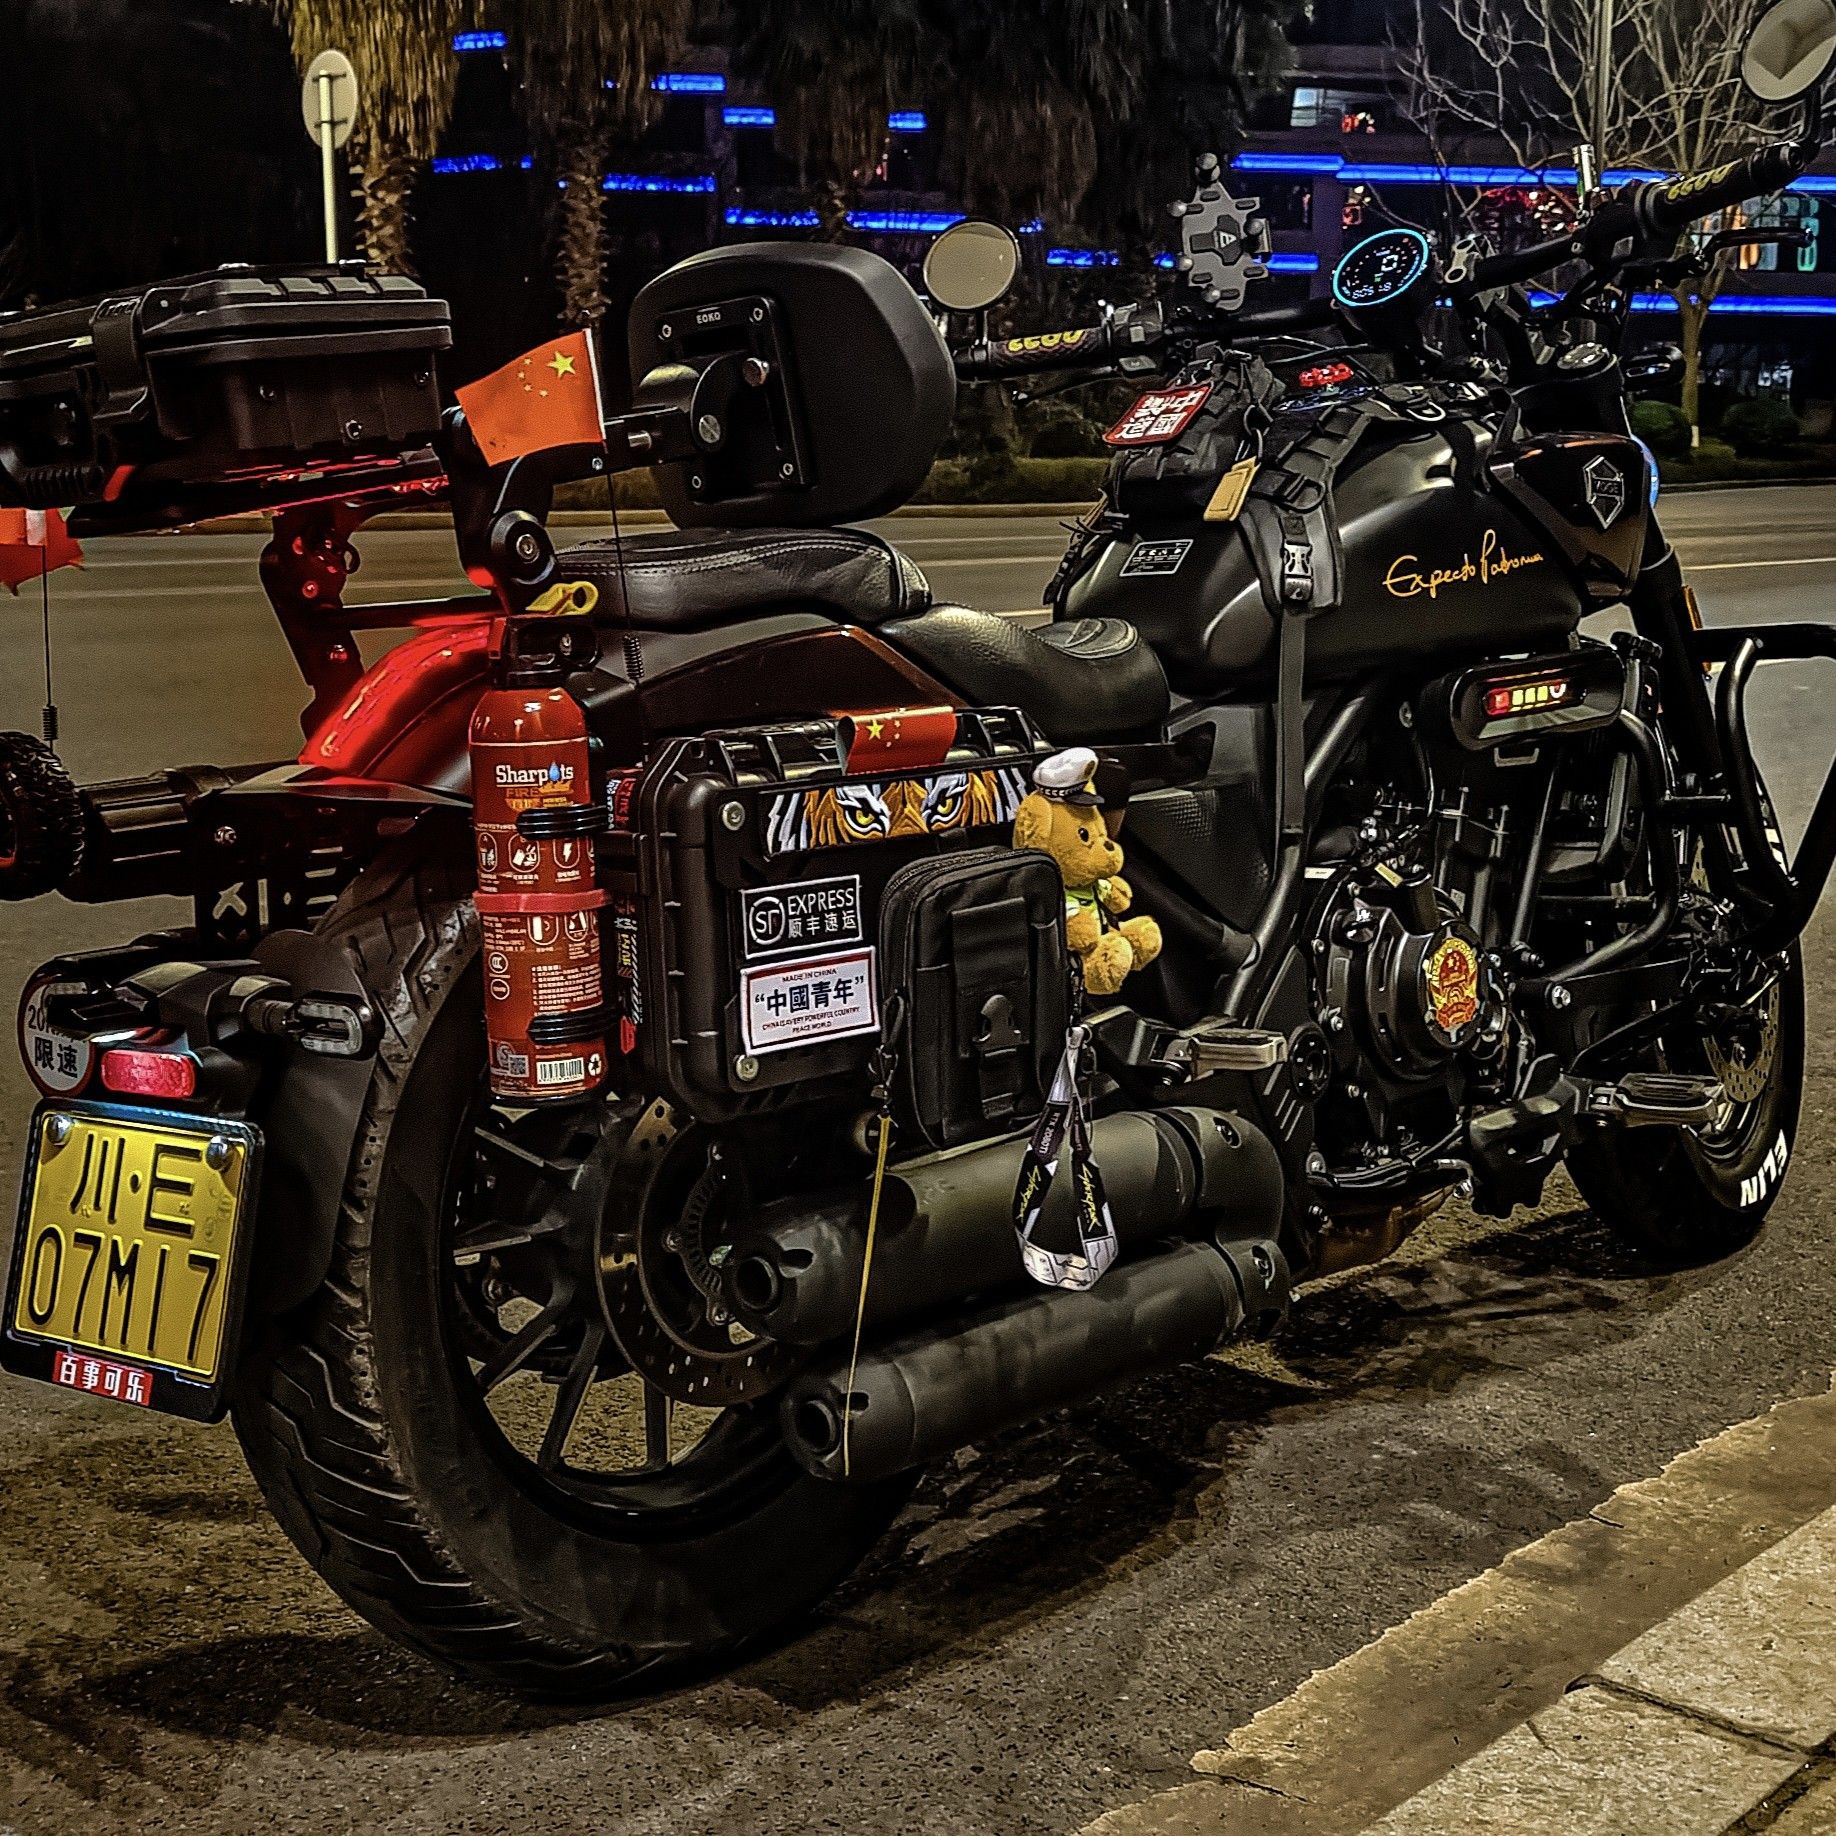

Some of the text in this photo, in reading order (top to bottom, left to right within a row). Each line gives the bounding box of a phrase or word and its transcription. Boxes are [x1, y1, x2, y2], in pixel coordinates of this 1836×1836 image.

[1382, 555, 1477, 599] Expecto
[788, 888, 854, 916] EXPRESS
[782, 974, 803, 983] MADE
[814, 968, 838, 979] CHINA
[35, 1036, 78, 1079] 限速
[28, 1224, 221, 1363] 07M17
[60, 1354, 145, 1403] 百事可乐
